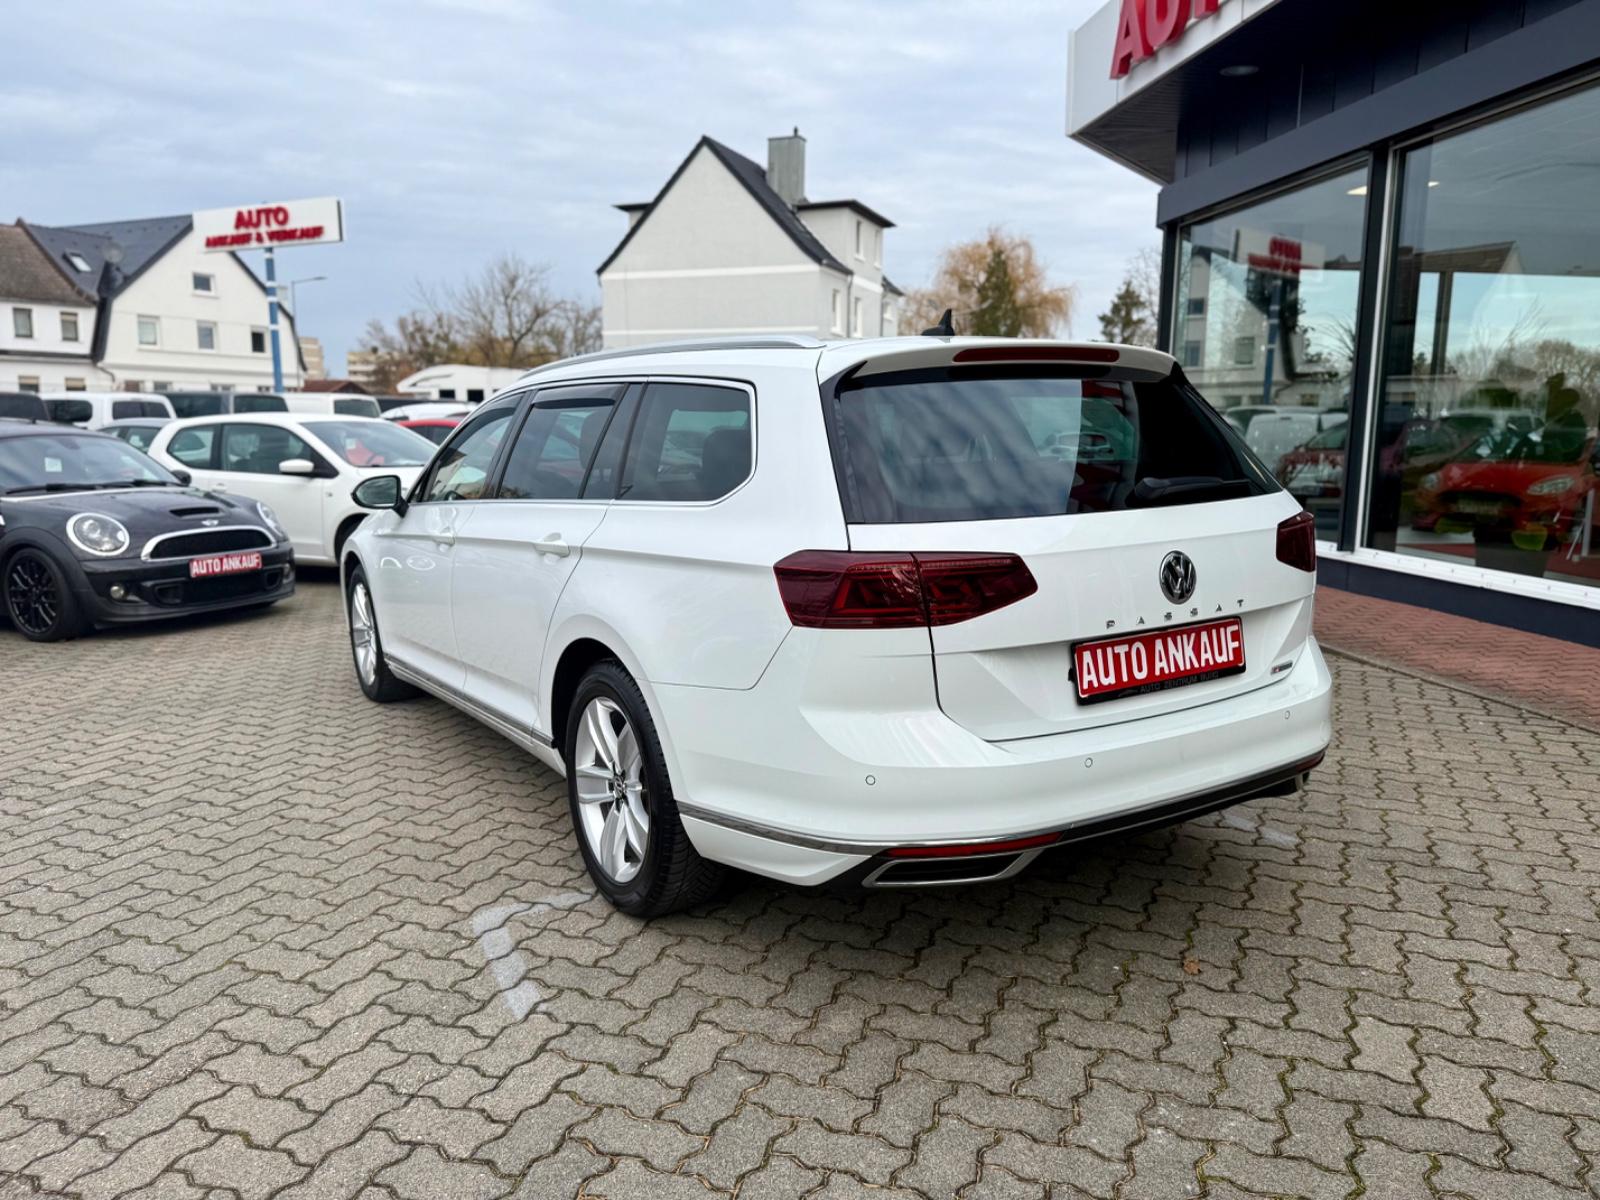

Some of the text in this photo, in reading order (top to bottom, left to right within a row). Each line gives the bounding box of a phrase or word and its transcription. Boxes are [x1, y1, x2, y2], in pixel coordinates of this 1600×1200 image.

[1110, 0, 1219, 80] AU
[235, 206, 289, 229] AUTO
[192, 553, 261, 575] AUTO ANKAUF
[1106, 599, 1244, 629] PASSAT
[1082, 624, 1240, 689] AUTO ANKAUF
